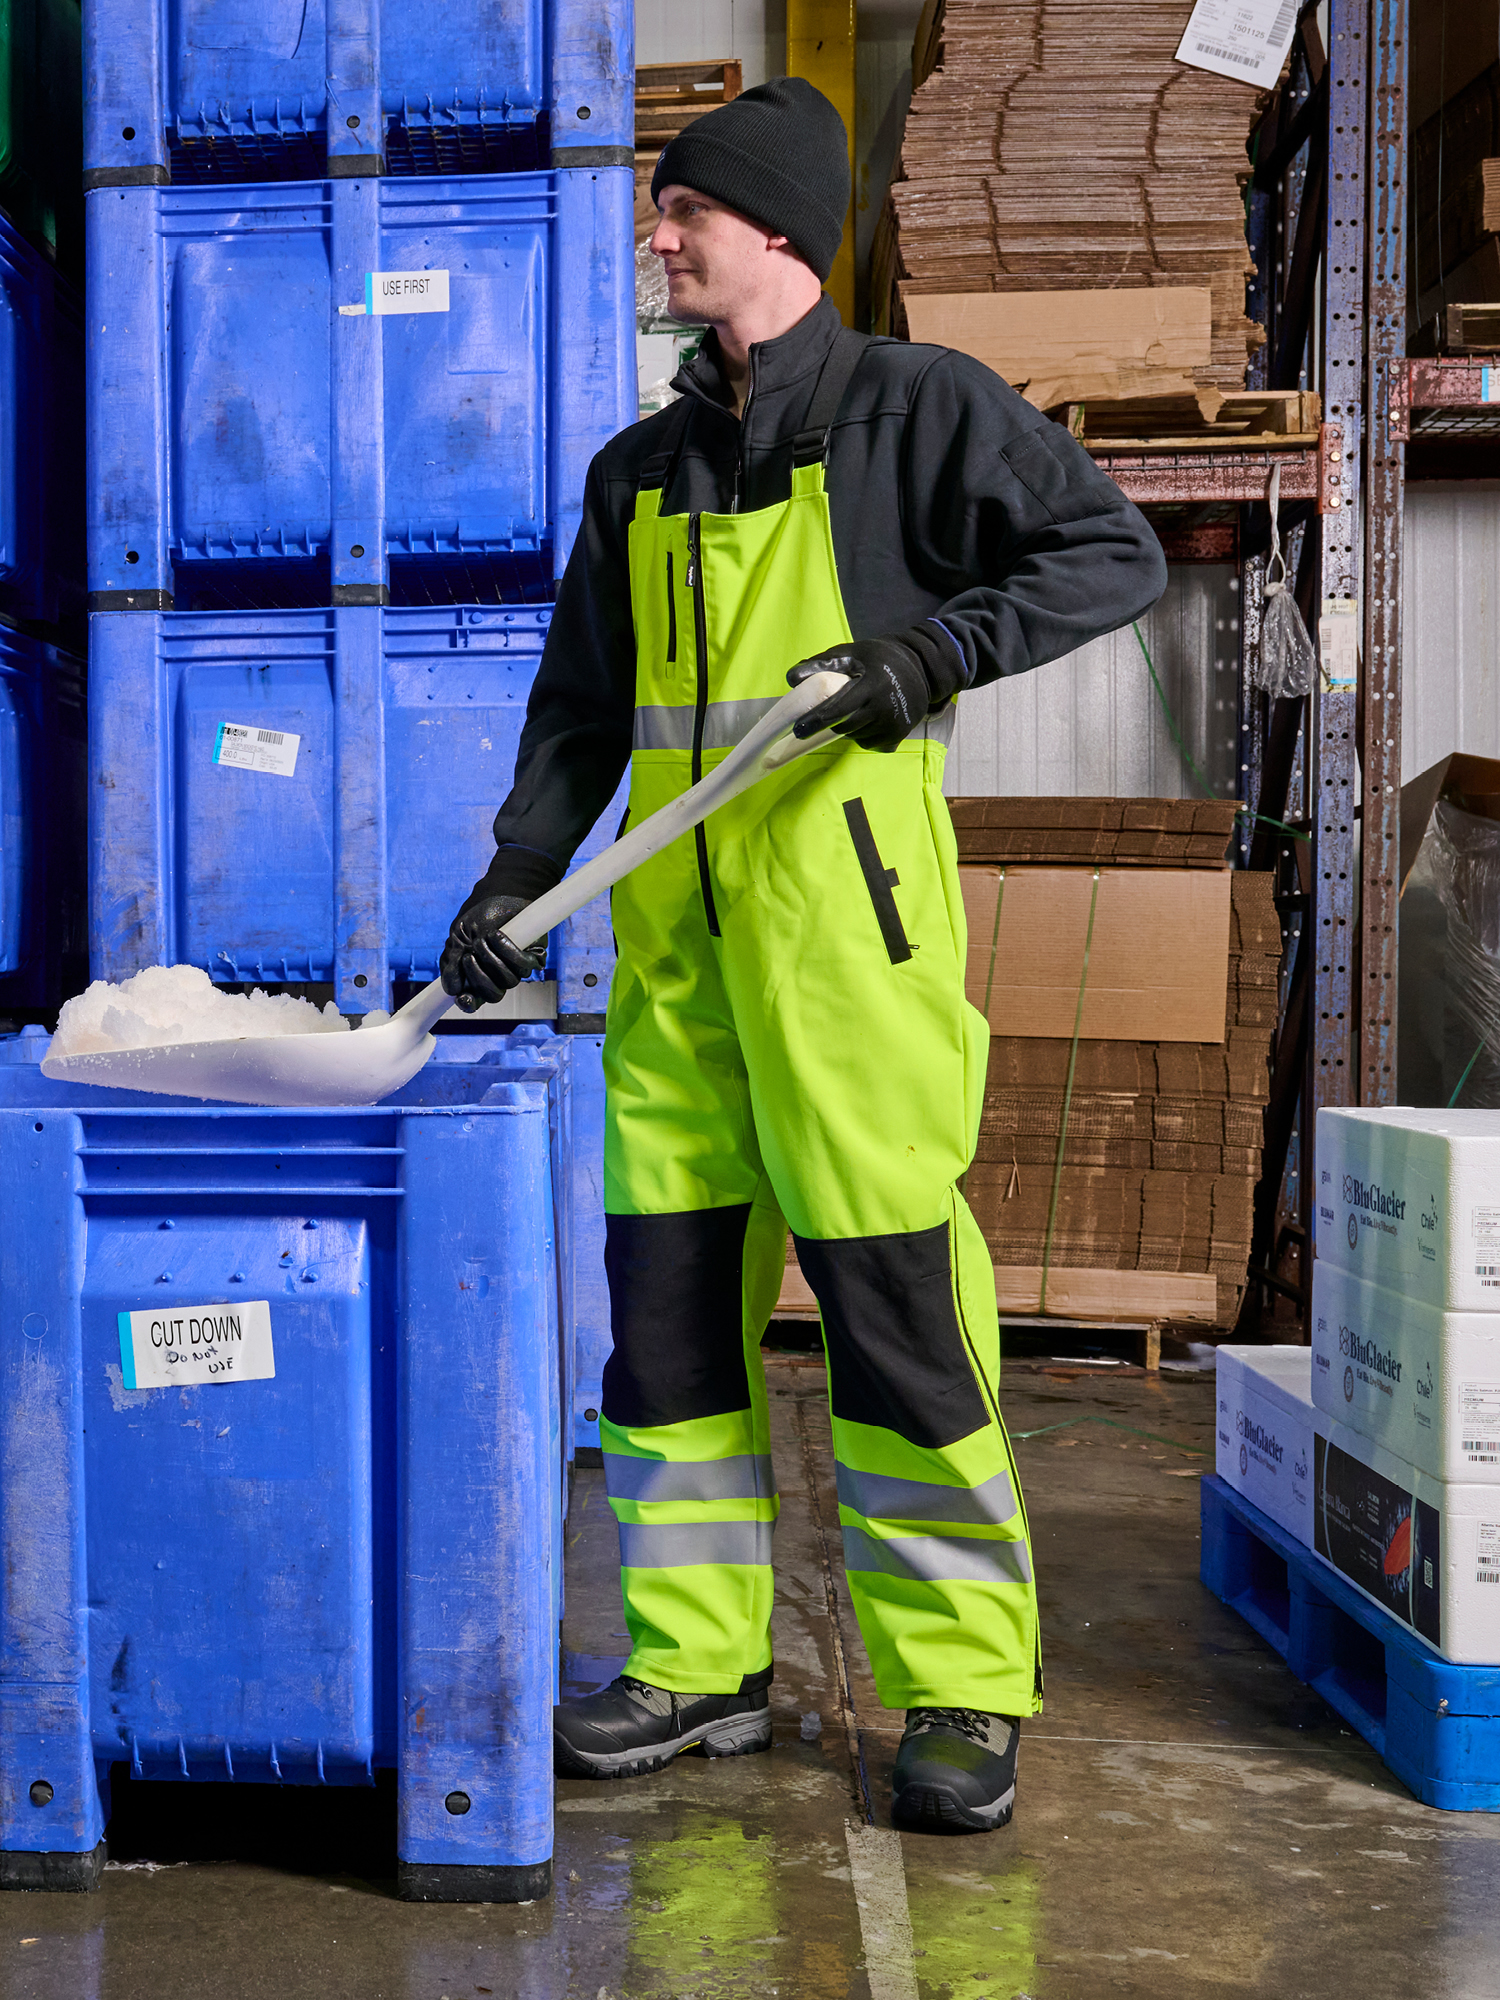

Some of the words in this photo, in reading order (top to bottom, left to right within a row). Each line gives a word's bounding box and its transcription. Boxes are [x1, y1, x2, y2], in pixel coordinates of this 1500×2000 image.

[1233, 24, 1265, 39] 1501125
[383, 281, 401, 295] USE
[404, 279, 430, 294] FIRST
[1354, 1180, 1406, 1220] BluGlacier
[1421, 1213, 1434, 1231] Chile
[151, 1320, 183, 1347] CUT
[189, 1316, 242, 1344] DOWN
[1350, 1331, 1402, 1383] BluGlacier
[1416, 1379, 1430, 1399] Chile
[1244, 1416, 1283, 1463] BluGlacier
